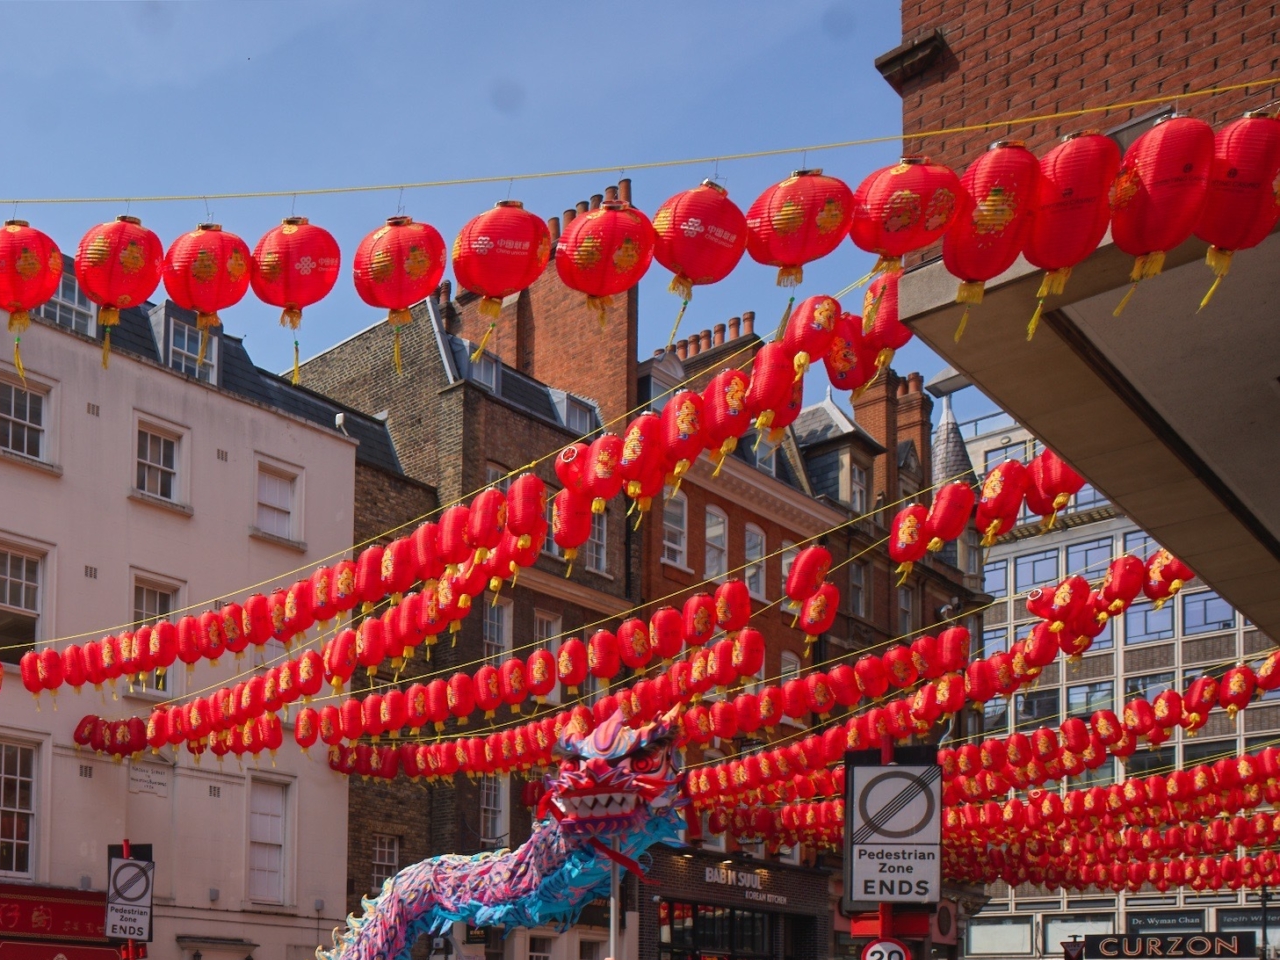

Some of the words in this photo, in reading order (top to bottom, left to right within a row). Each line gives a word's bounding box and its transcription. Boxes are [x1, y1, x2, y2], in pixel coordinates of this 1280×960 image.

[858, 849, 935, 861] Pedestrian
[878, 863, 913, 874] Zone
[705, 867, 726, 885] BAB
[738, 872, 762, 889] SUUL
[863, 880, 930, 896] ENDS
[745, 891, 767, 902] KOREAN
[767, 893, 787, 904] KITCHEN
[110, 906, 148, 916] Pedestrian
[120, 914, 137, 923] Zone
[1223, 915, 1248, 923] Teeth
[111, 924, 144, 936] ENDS
[1098, 935, 1238, 956] CURZON
